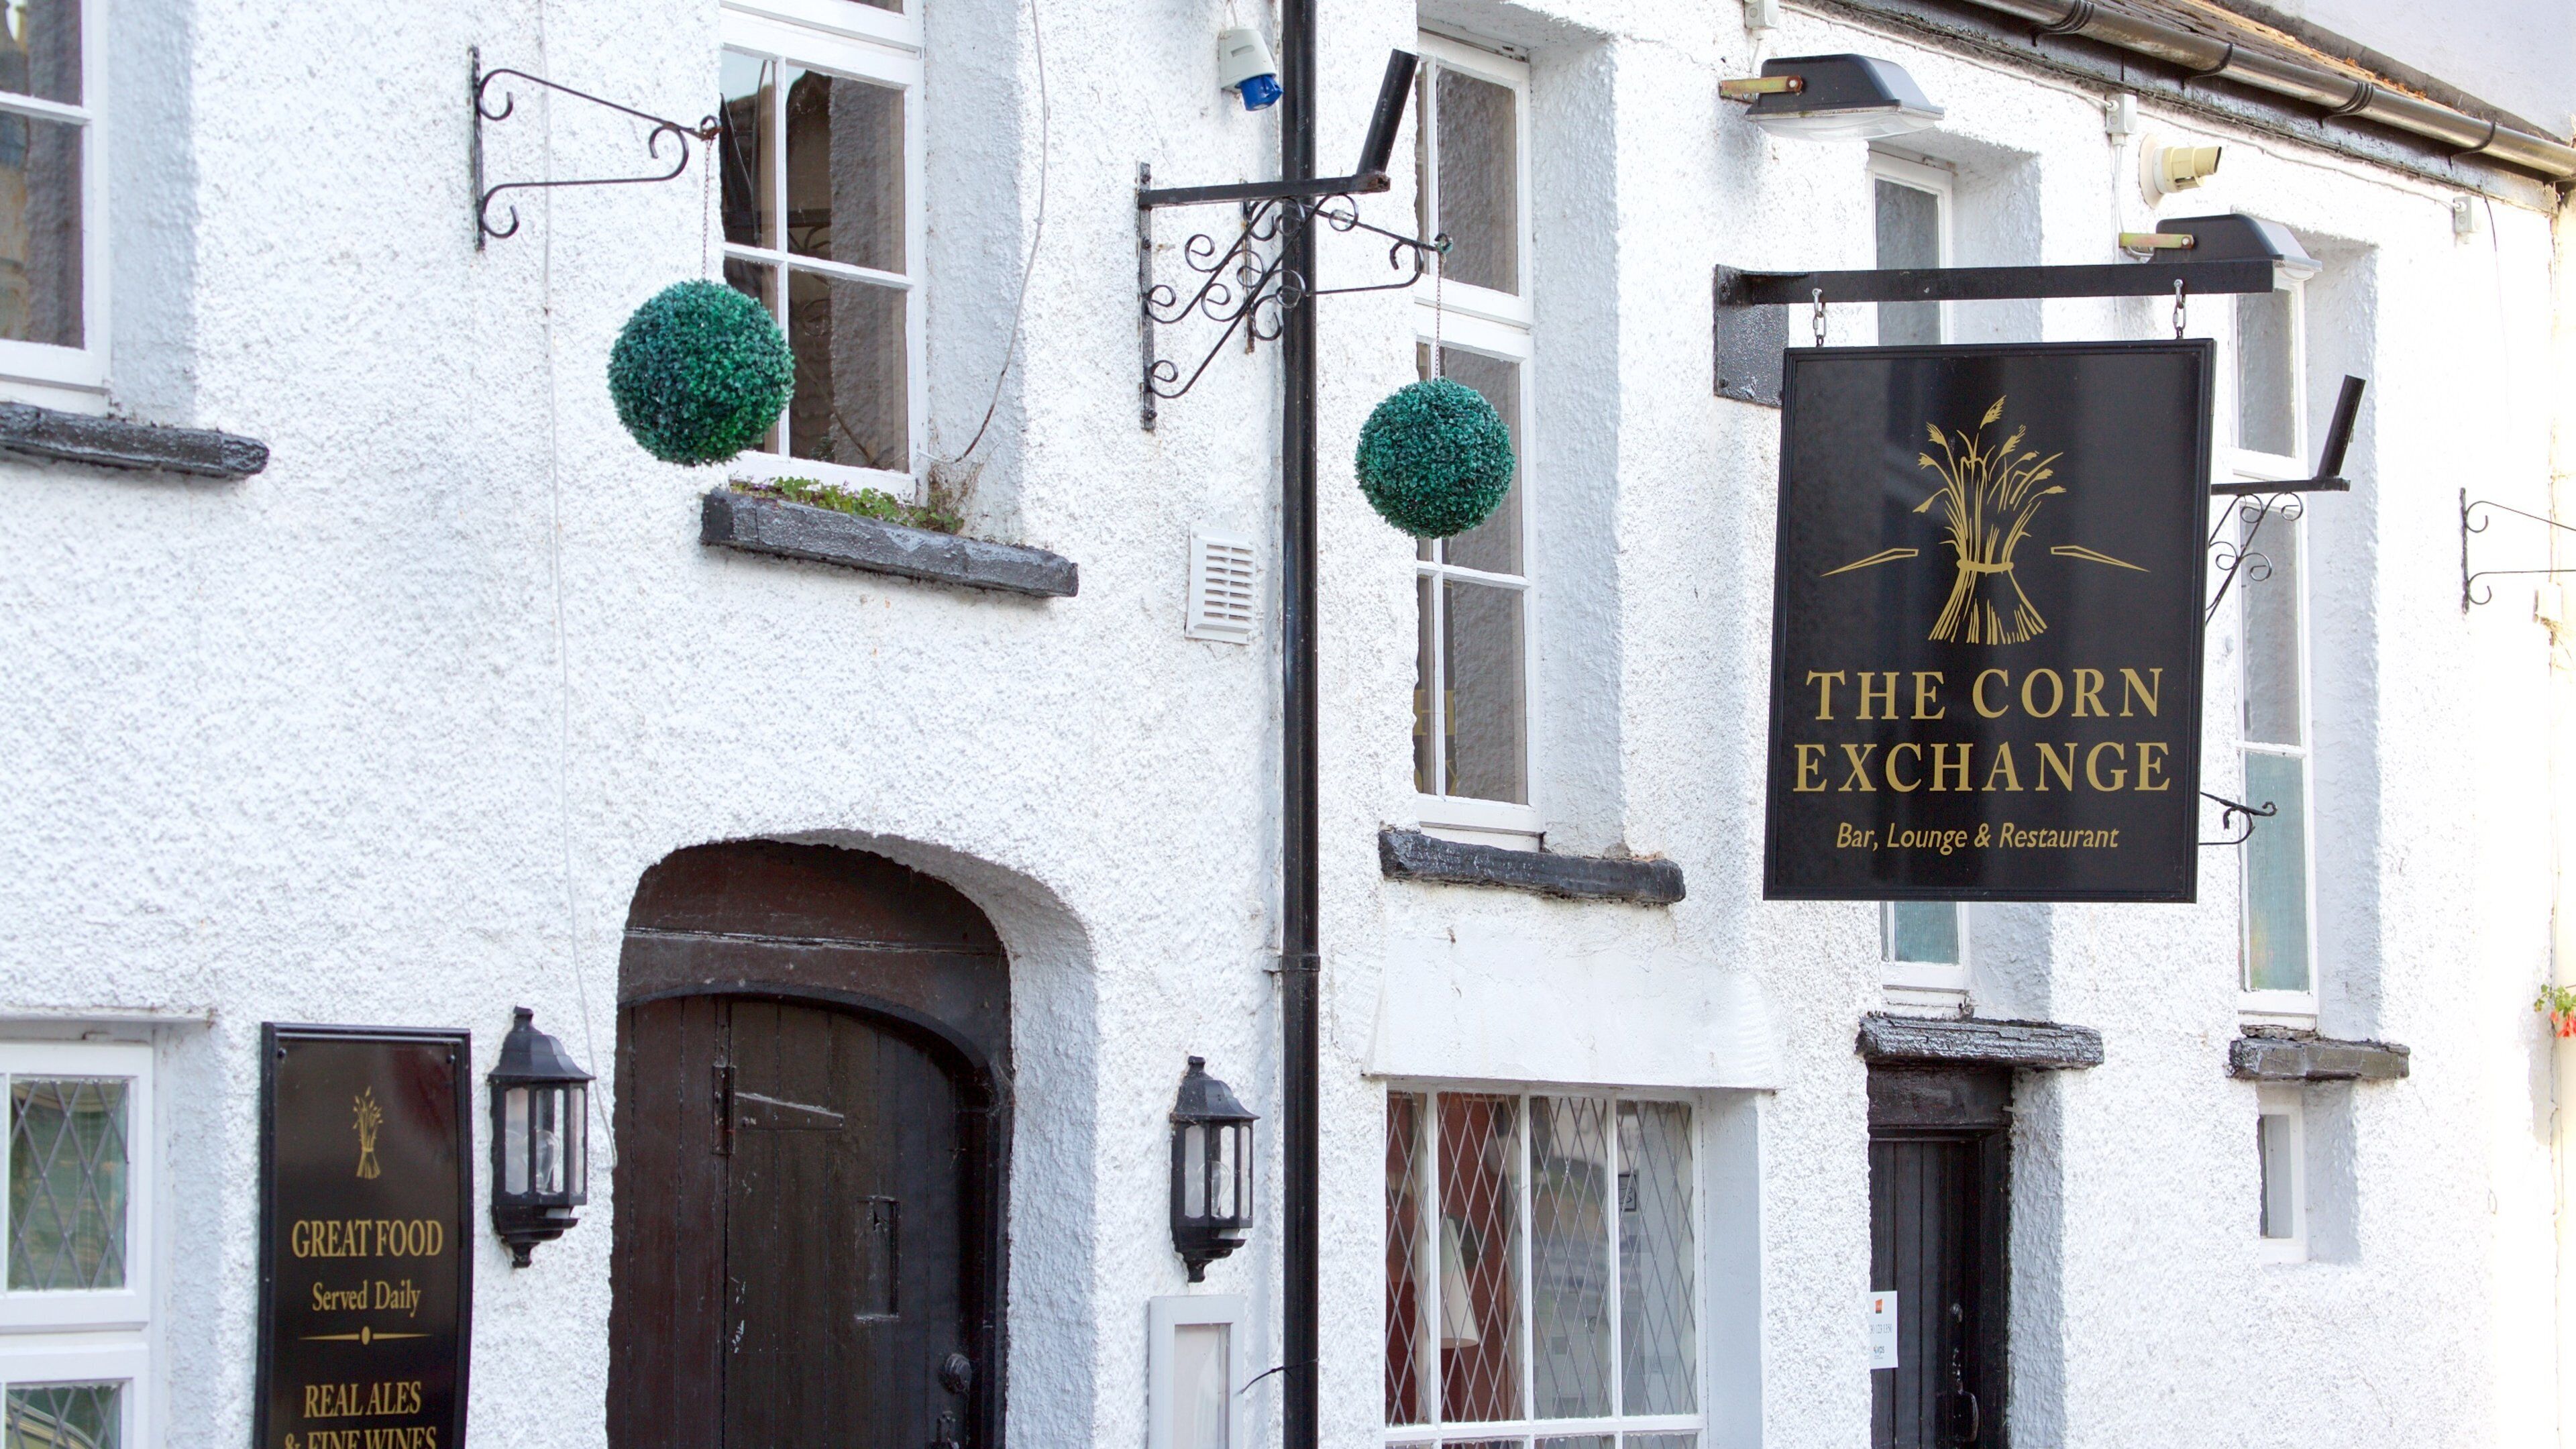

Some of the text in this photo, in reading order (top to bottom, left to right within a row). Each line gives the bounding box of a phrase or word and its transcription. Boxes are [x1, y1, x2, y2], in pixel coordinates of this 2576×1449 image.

[1807, 668, 2163, 720] THE CORN
[1793, 742, 2171, 793] EXCHANGE
[1837, 822, 2119, 856] Bar, Lounge & Restaurant
[292, 1220, 443, 1258] GREAT FOOD
[312, 1279, 421, 1318] Served Daily
[304, 1381, 422, 1418] REAL ALES
[307, 1430, 360, 1449] FINE
[364, 1426, 437, 1449] WINES
